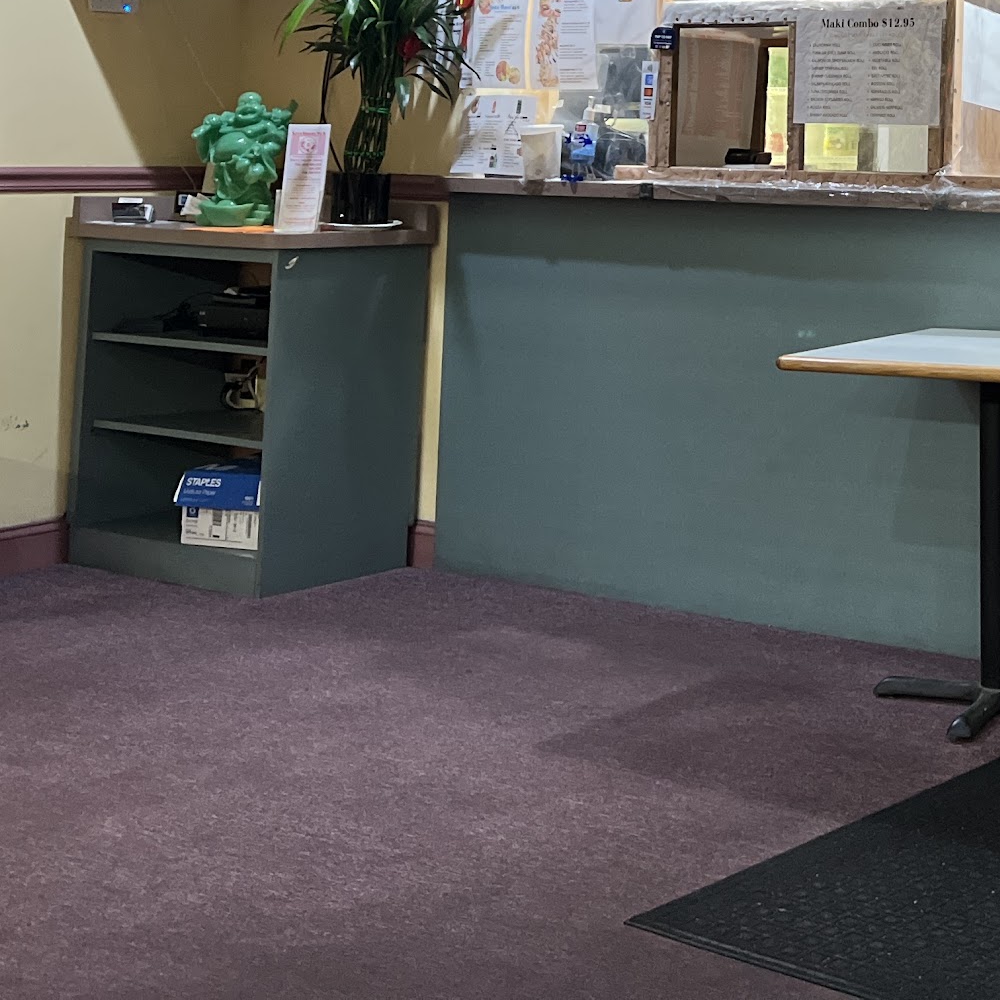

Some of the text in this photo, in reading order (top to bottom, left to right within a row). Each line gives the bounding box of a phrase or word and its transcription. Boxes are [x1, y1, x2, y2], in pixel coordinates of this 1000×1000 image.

[822, 17, 915, 28] Maki Combo $12.95
[186, 478, 222, 487] STAPLES
